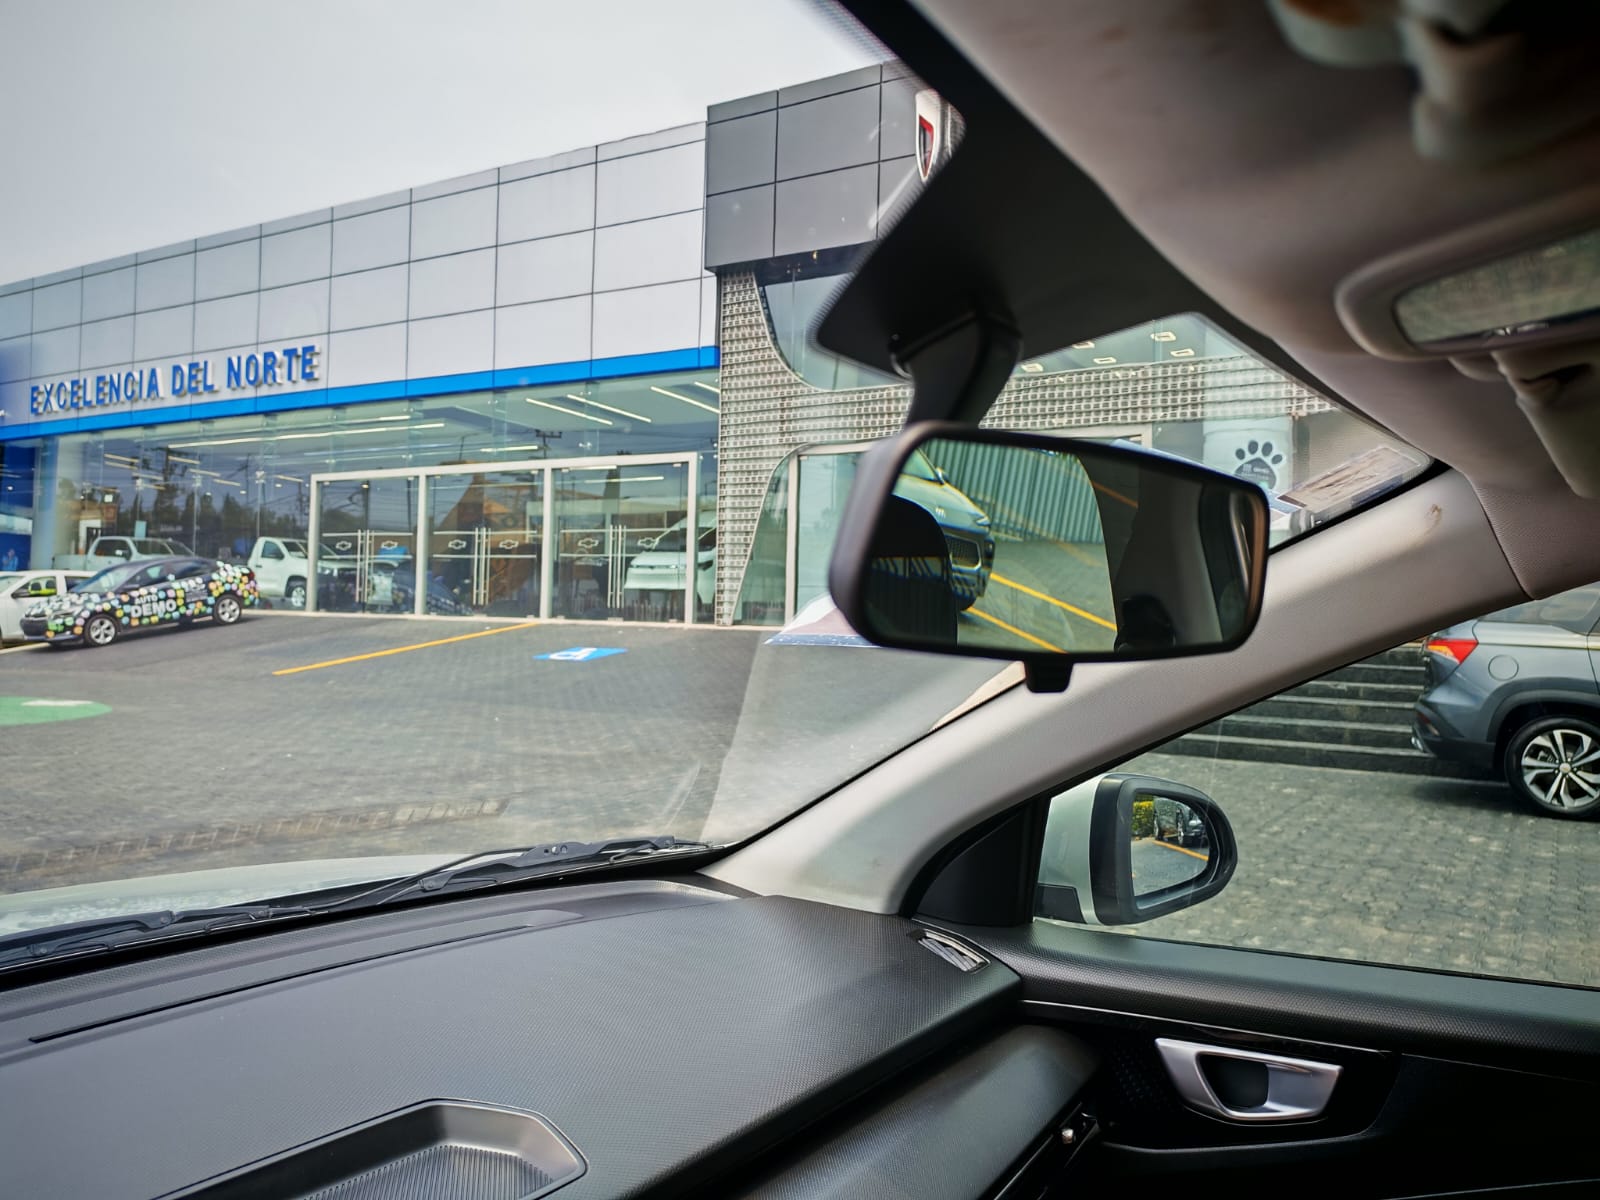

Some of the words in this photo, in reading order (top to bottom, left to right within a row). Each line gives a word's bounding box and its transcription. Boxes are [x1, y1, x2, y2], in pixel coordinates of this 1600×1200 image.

[30, 367, 162, 415] EXCELENCIA
[171, 359, 216, 396] DEL
[227, 344, 318, 388] NORTE
[130, 599, 177, 618] DEMO
[135, 594, 159, 605] AUTO
